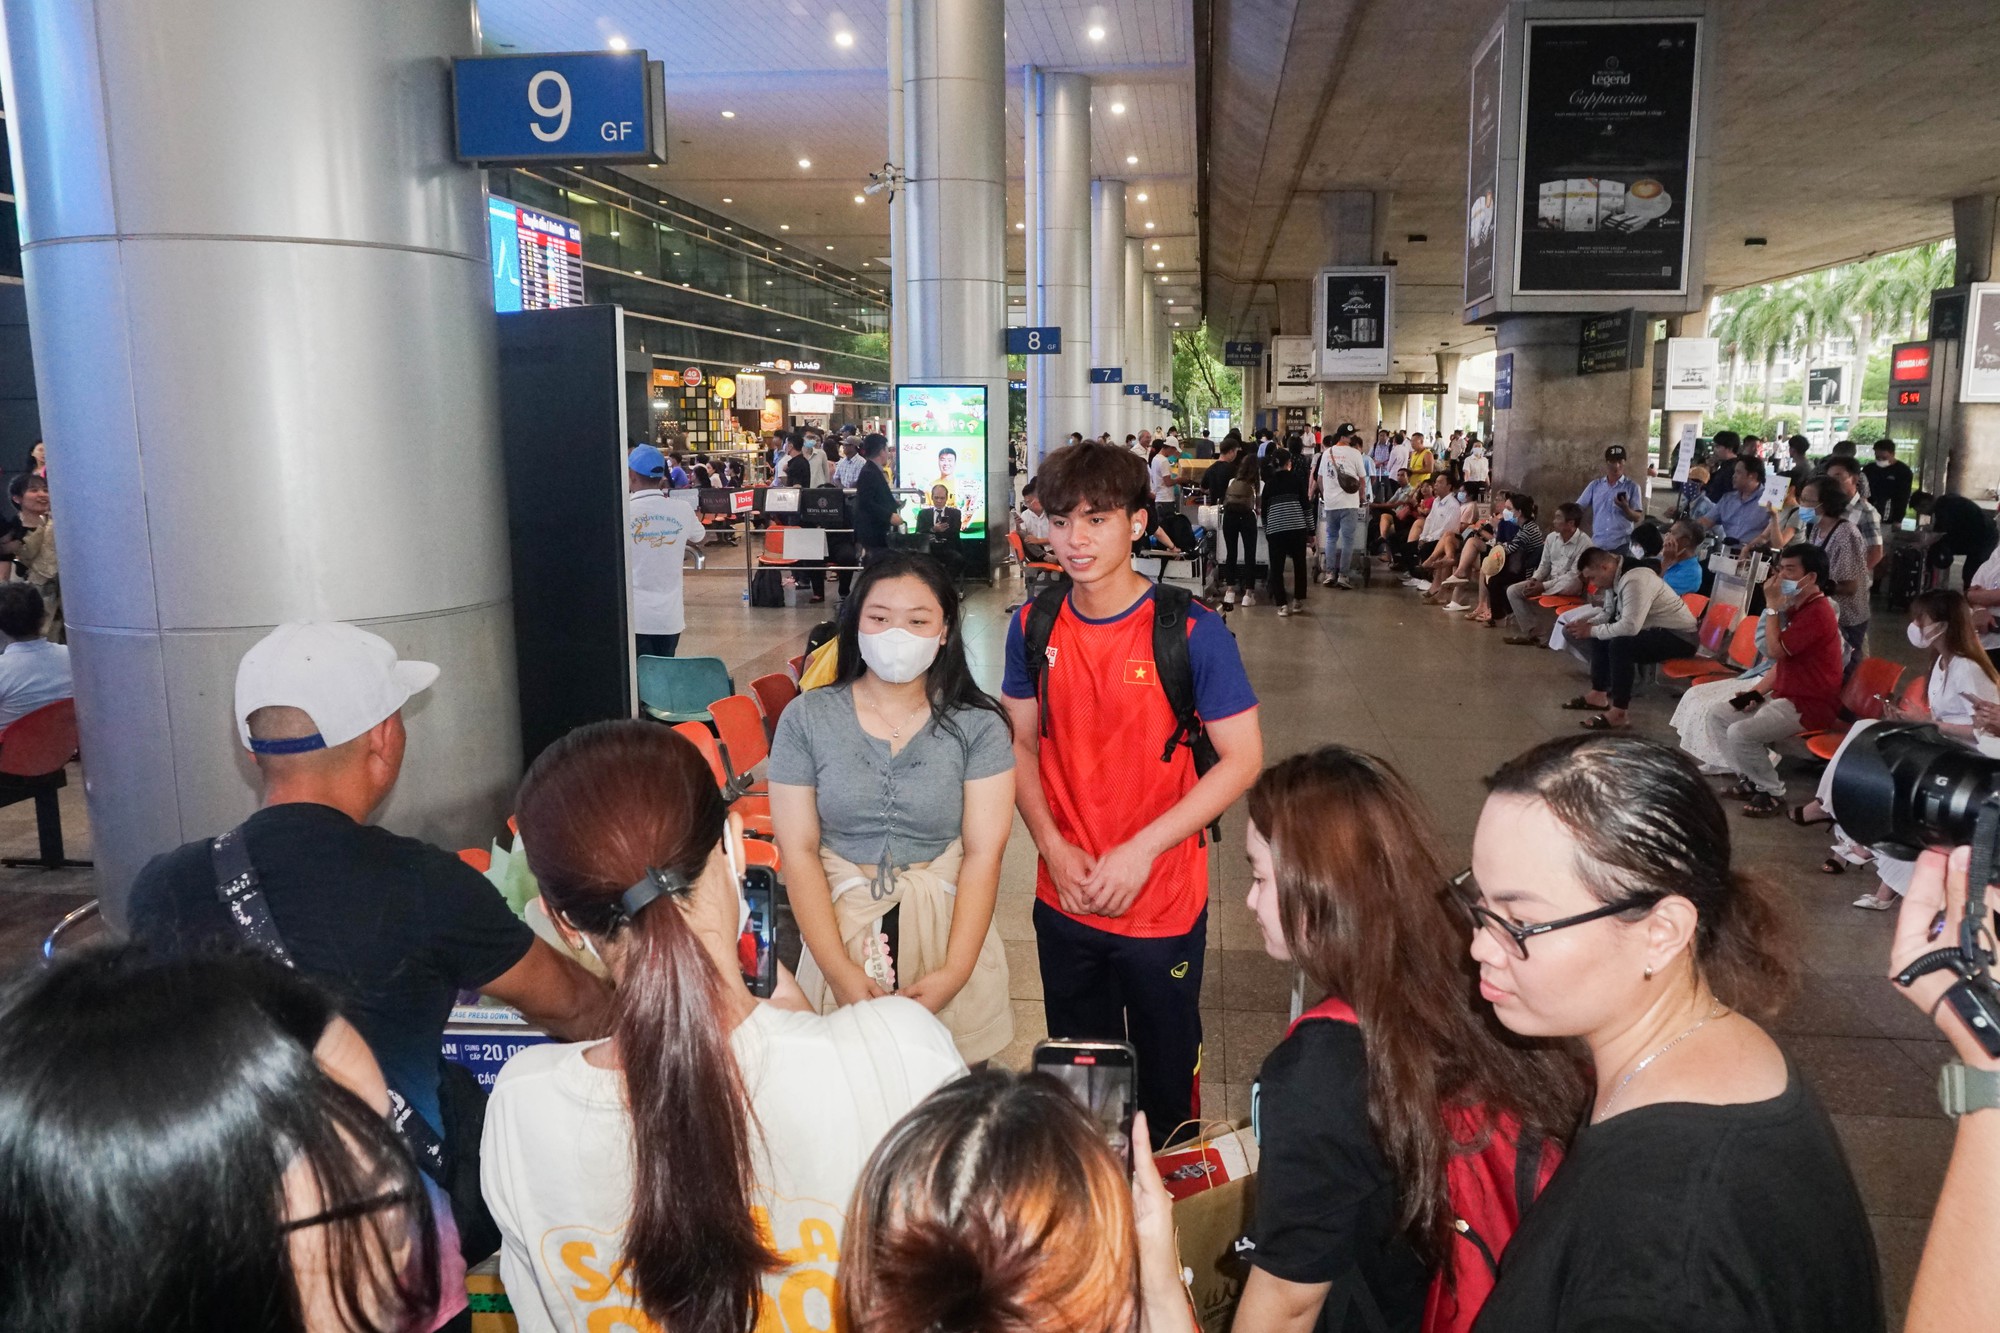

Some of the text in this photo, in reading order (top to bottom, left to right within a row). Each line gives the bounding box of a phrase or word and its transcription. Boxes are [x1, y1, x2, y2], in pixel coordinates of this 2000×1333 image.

[1592, 73, 1630, 87] Legend
[1569, 89, 1648, 110] Cappuccino
[527, 70, 633, 142] 9 GF
[1028, 331, 1041, 350] 8
[1102, 370, 1111, 381] 7
[1133, 386, 1140, 394] 6
[738, 495, 752, 503] ibis
[490, 1012, 509, 1020] DOWN
[465, 1044, 480, 1052] CUNG
